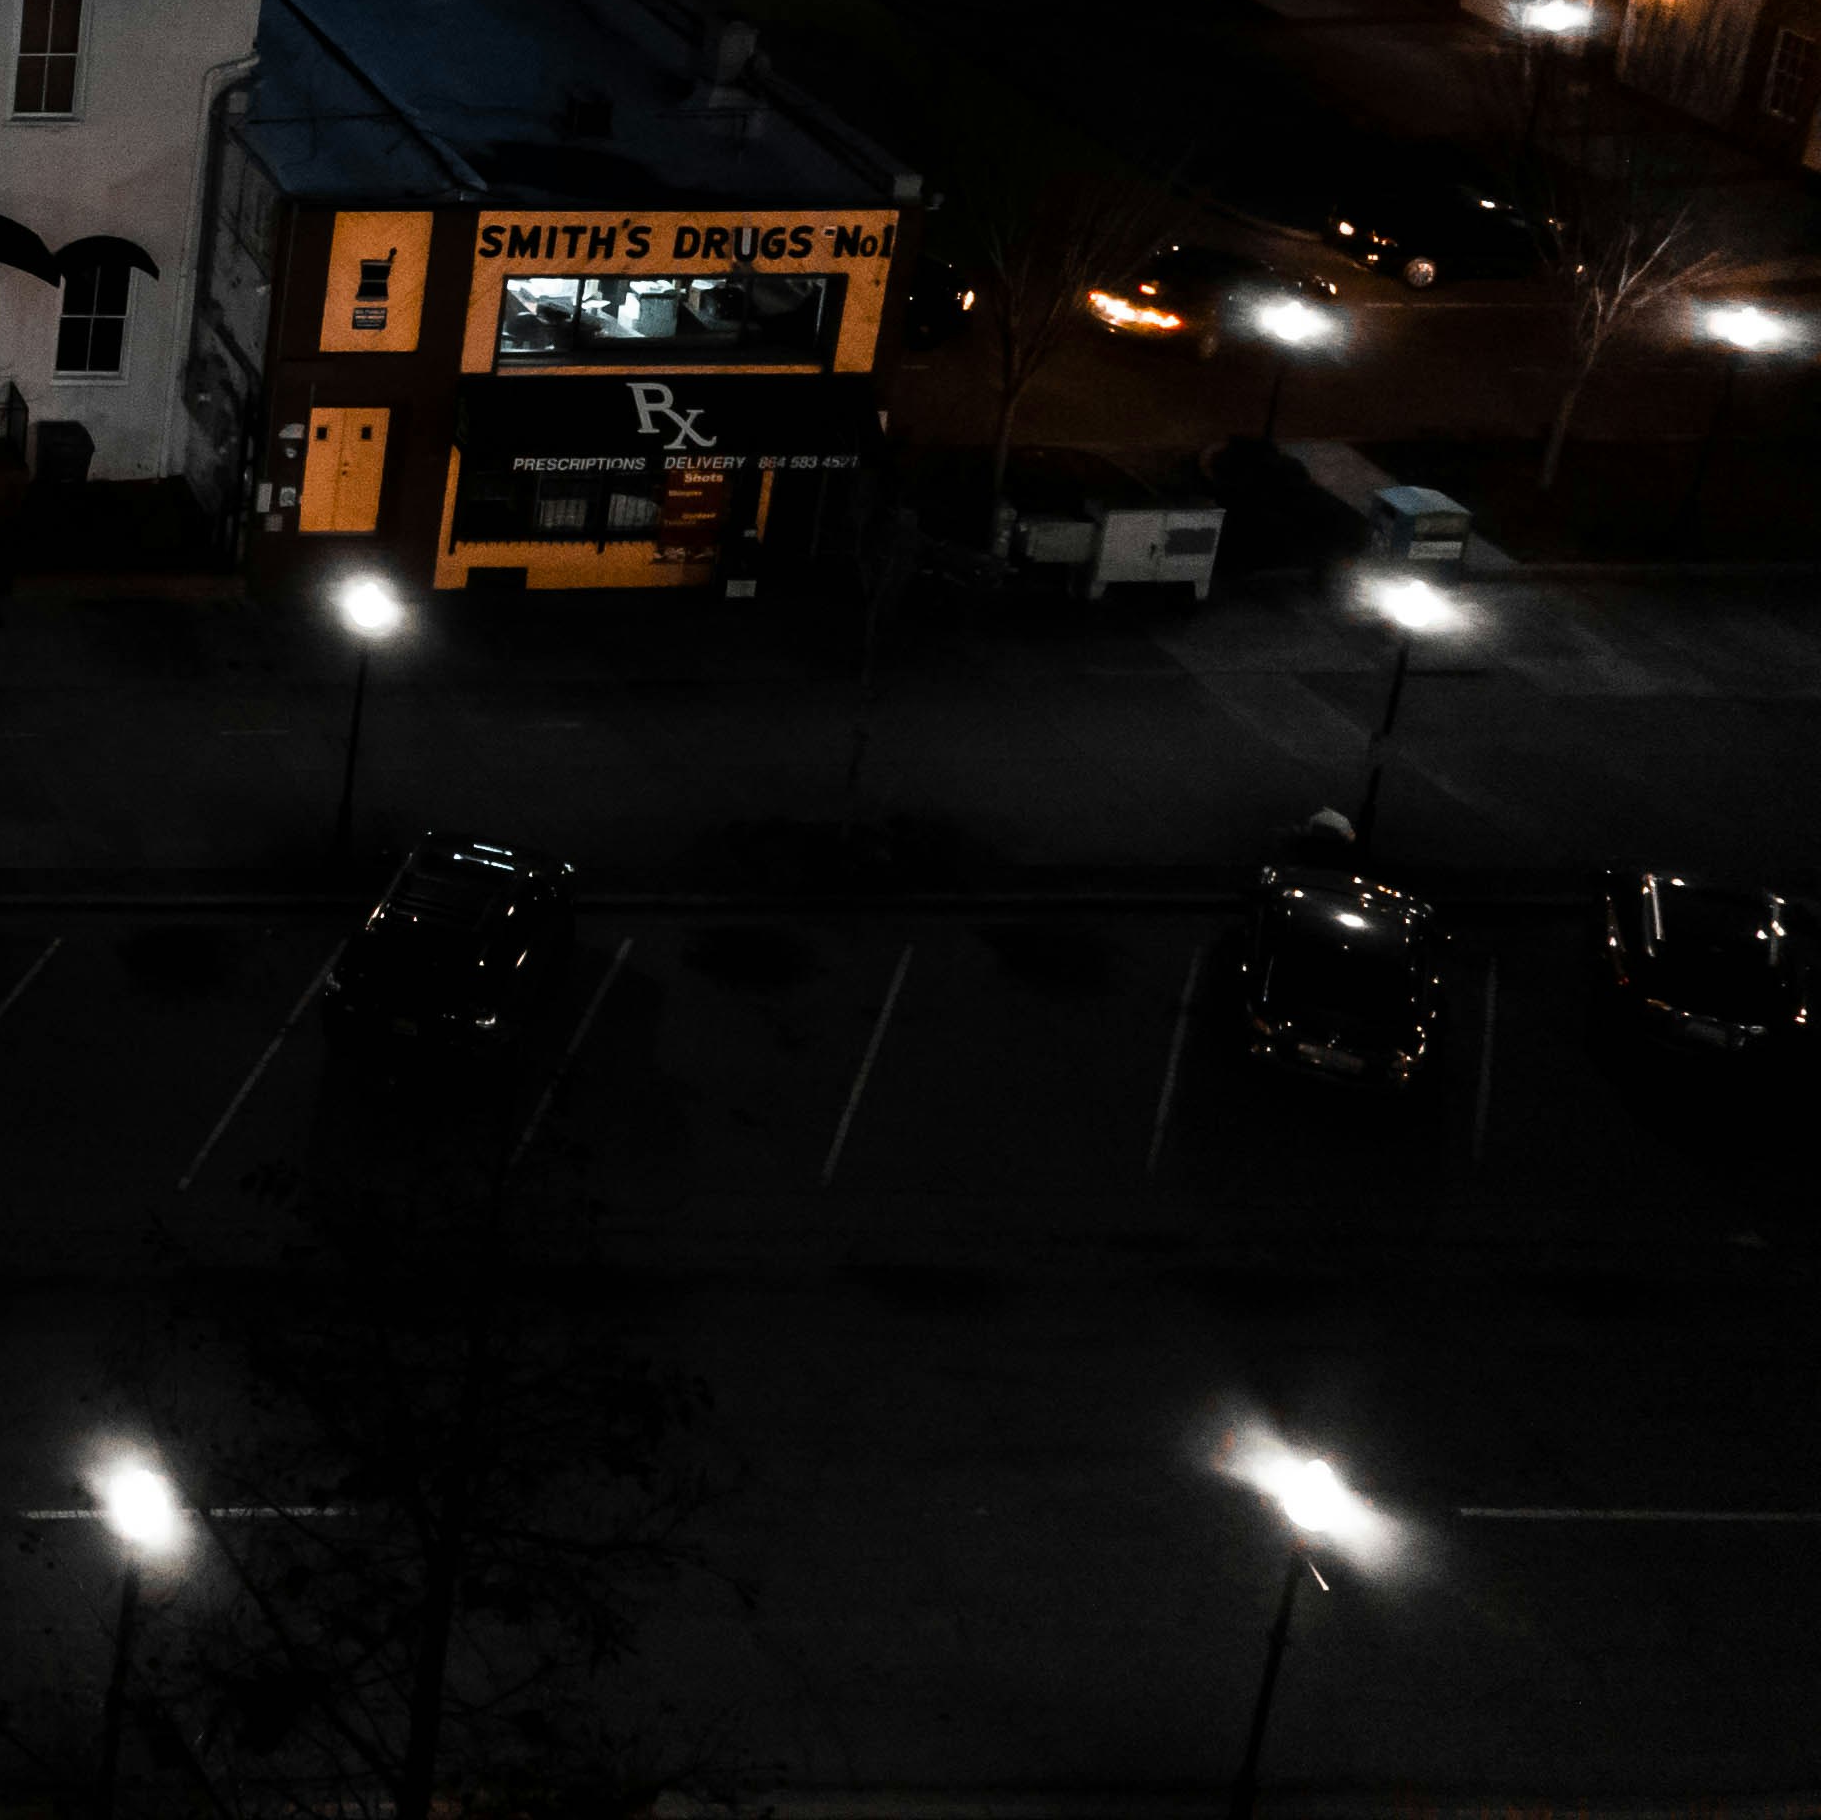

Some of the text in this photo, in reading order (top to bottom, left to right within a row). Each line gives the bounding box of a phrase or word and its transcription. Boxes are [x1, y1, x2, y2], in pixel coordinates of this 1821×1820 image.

[479, 218, 652, 260] SMITH'S
[672, 226, 813, 262] DRUGS
[512, 456, 646, 471] PRESCRIPTIONS
[663, 455, 746, 470] DELIVERY
[789, 455, 817, 470] 583
[684, 472, 724, 483] Shots
